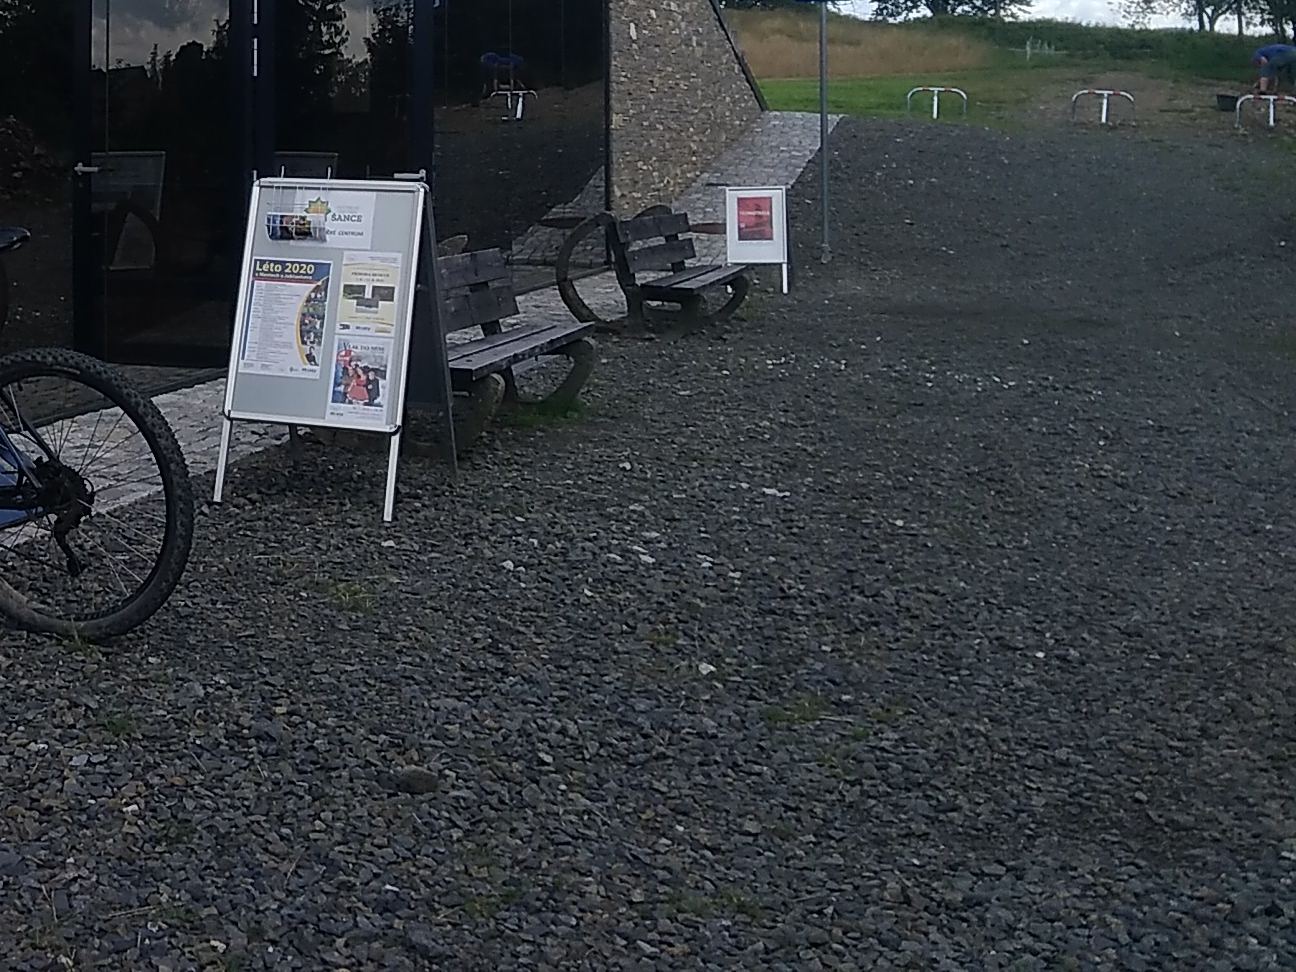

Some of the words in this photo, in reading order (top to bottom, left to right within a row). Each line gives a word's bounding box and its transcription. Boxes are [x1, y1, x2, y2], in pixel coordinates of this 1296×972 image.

[331, 213, 363, 223] ŠANCE
[255, 261, 282, 273] Léto
[284, 263, 315, 275] 2020
